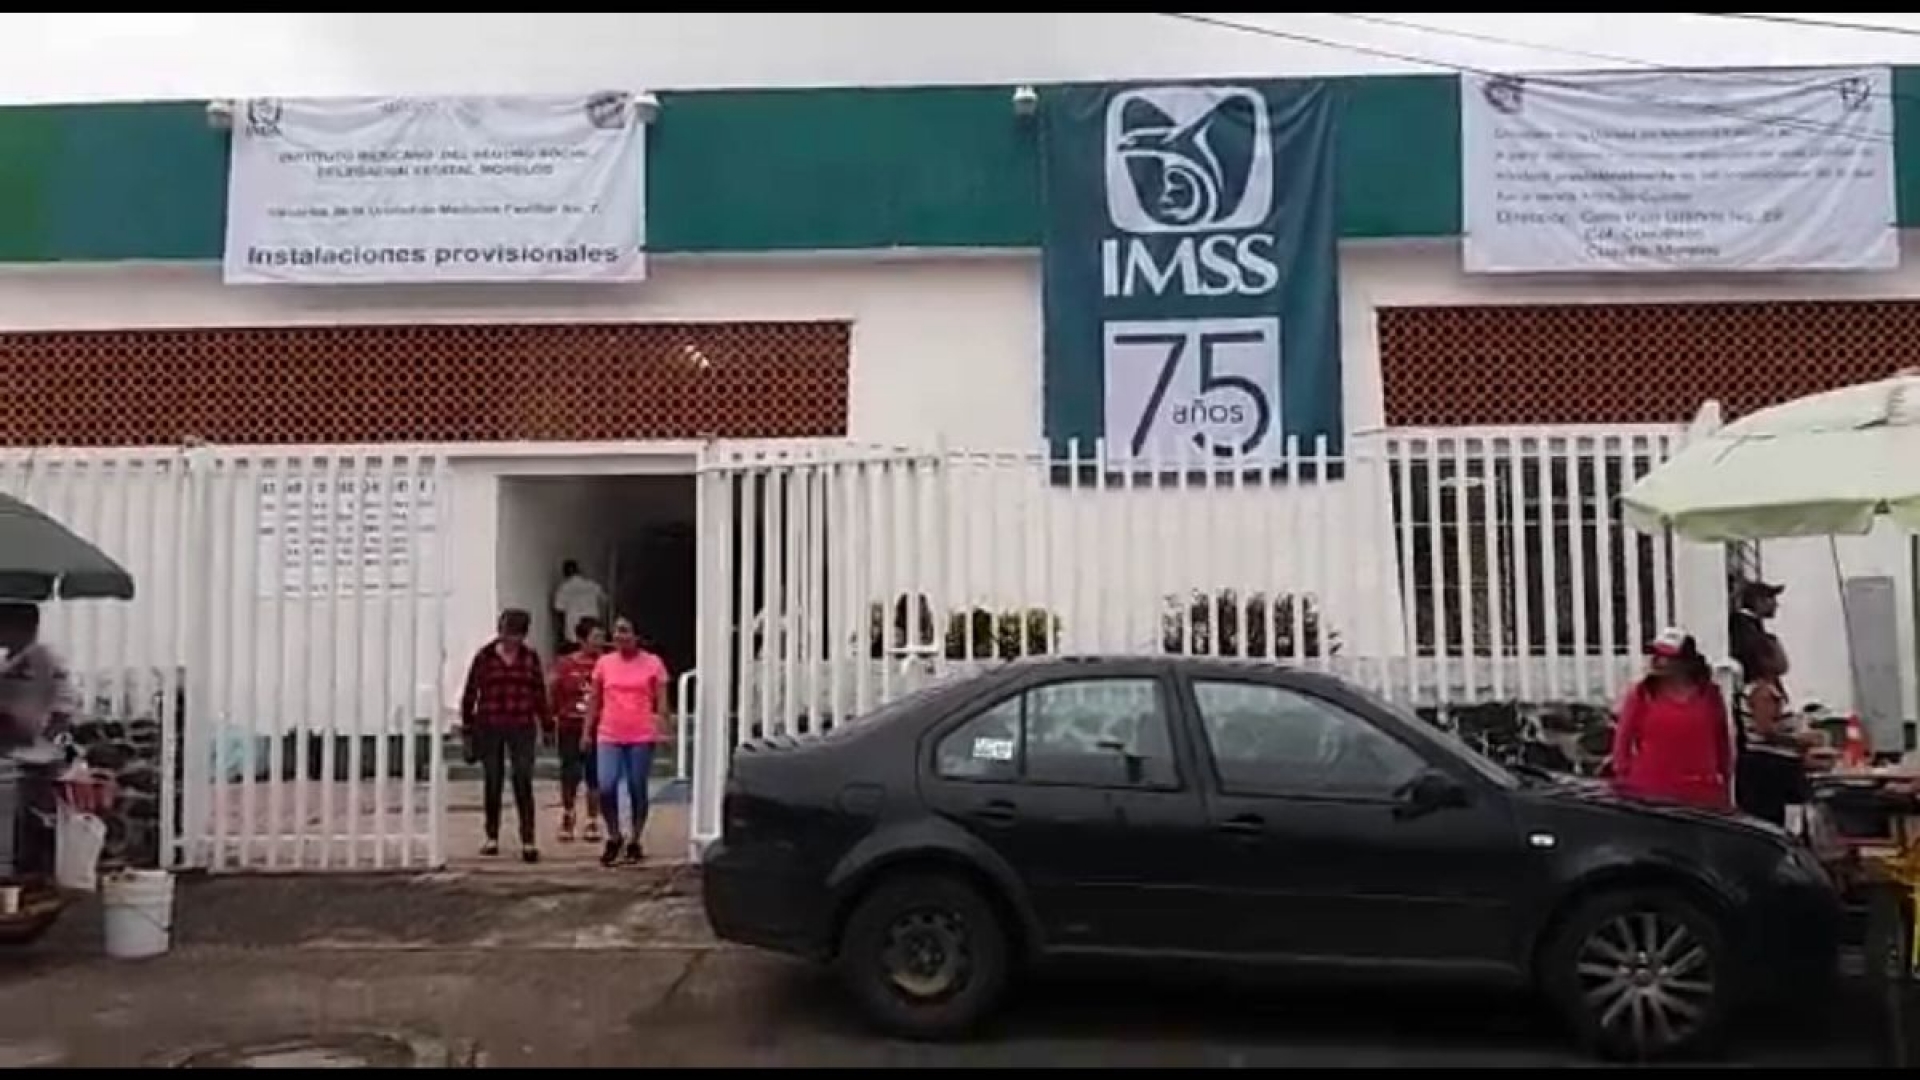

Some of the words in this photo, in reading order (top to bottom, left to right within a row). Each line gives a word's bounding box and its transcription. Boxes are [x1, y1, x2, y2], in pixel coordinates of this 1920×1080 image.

[480, 163, 553, 175] MORELOS
[248, 246, 427, 265] Instalaciones
[435, 245, 619, 266] provisionales
[1103, 233, 1280, 297] IMSS
[1113, 330, 1270, 457] 75
[1172, 399, 1244, 425] años
